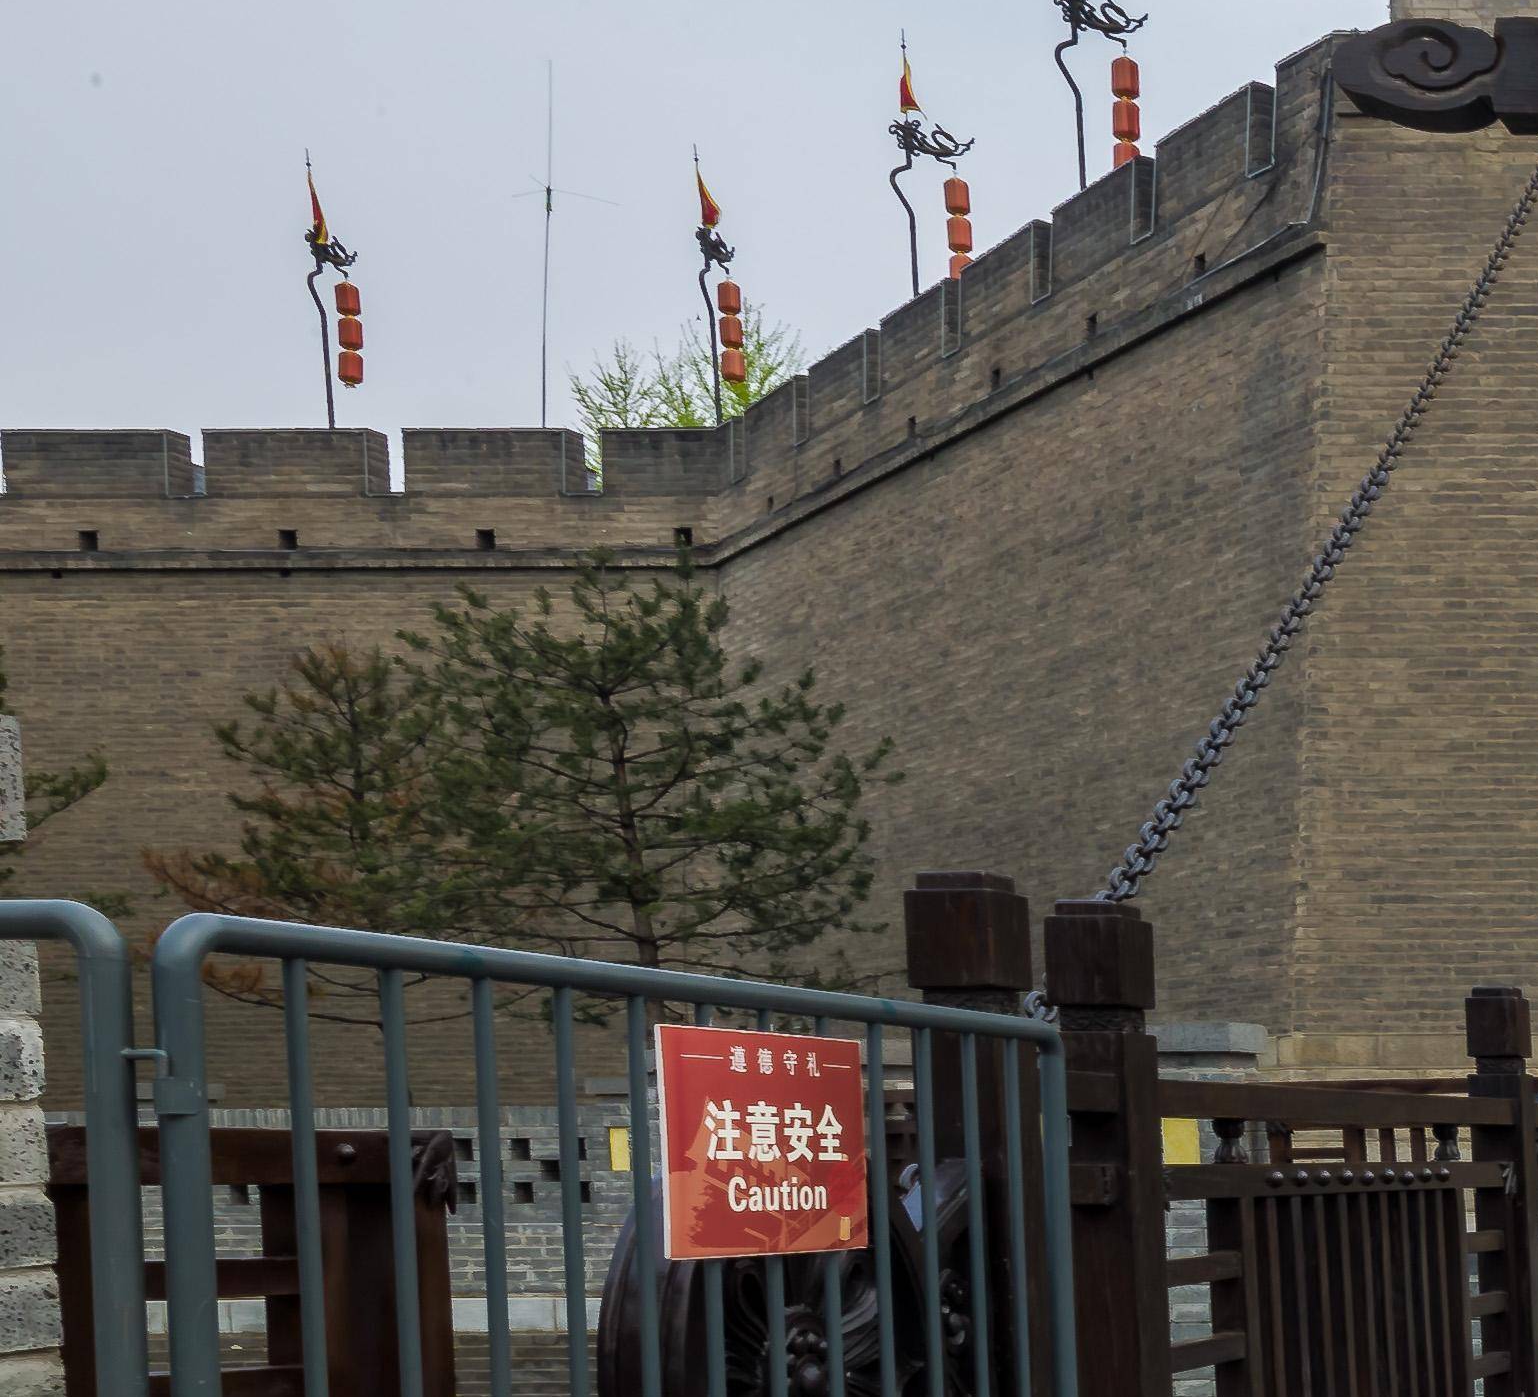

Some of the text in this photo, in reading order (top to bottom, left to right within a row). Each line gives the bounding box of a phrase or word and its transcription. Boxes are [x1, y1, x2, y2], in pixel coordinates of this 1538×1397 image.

[704, 1099, 846, 1162] 注意安全
[727, 1175, 828, 1212] Caution
